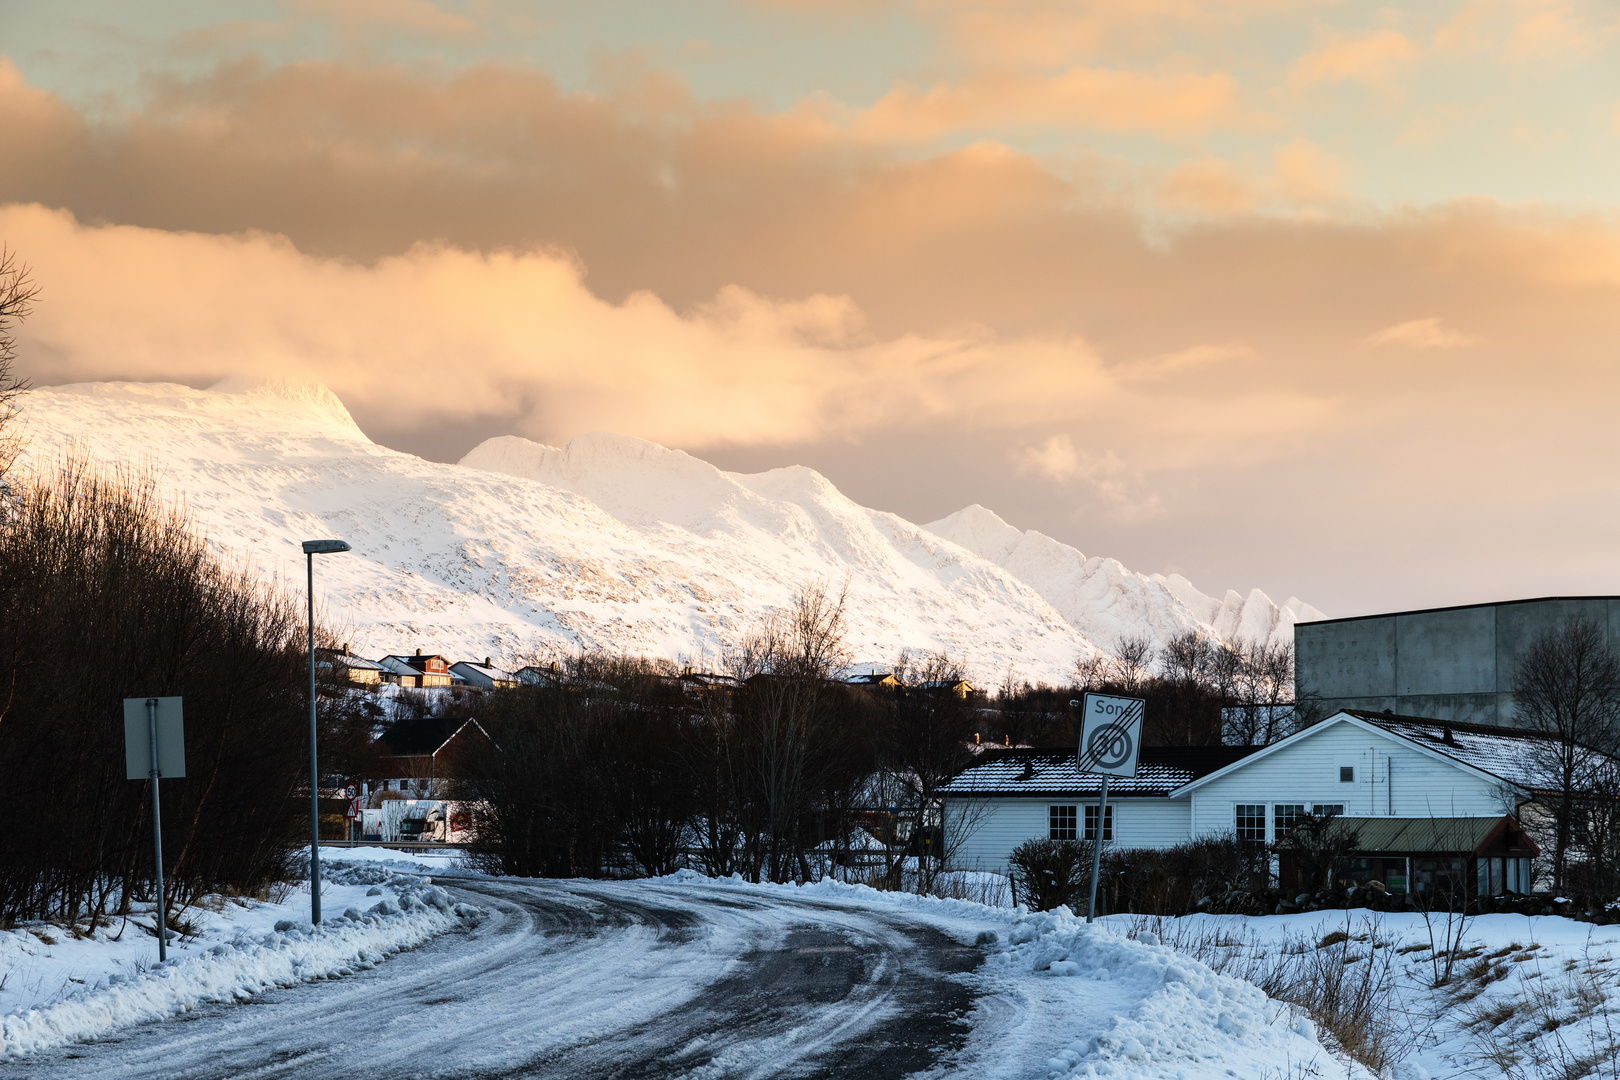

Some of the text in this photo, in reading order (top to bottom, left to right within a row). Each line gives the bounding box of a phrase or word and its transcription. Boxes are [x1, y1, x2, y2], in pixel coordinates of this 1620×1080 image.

[1095, 700, 1132, 717] Sone
[1096, 735, 1125, 758] 30
[348, 788, 356, 797] 50
